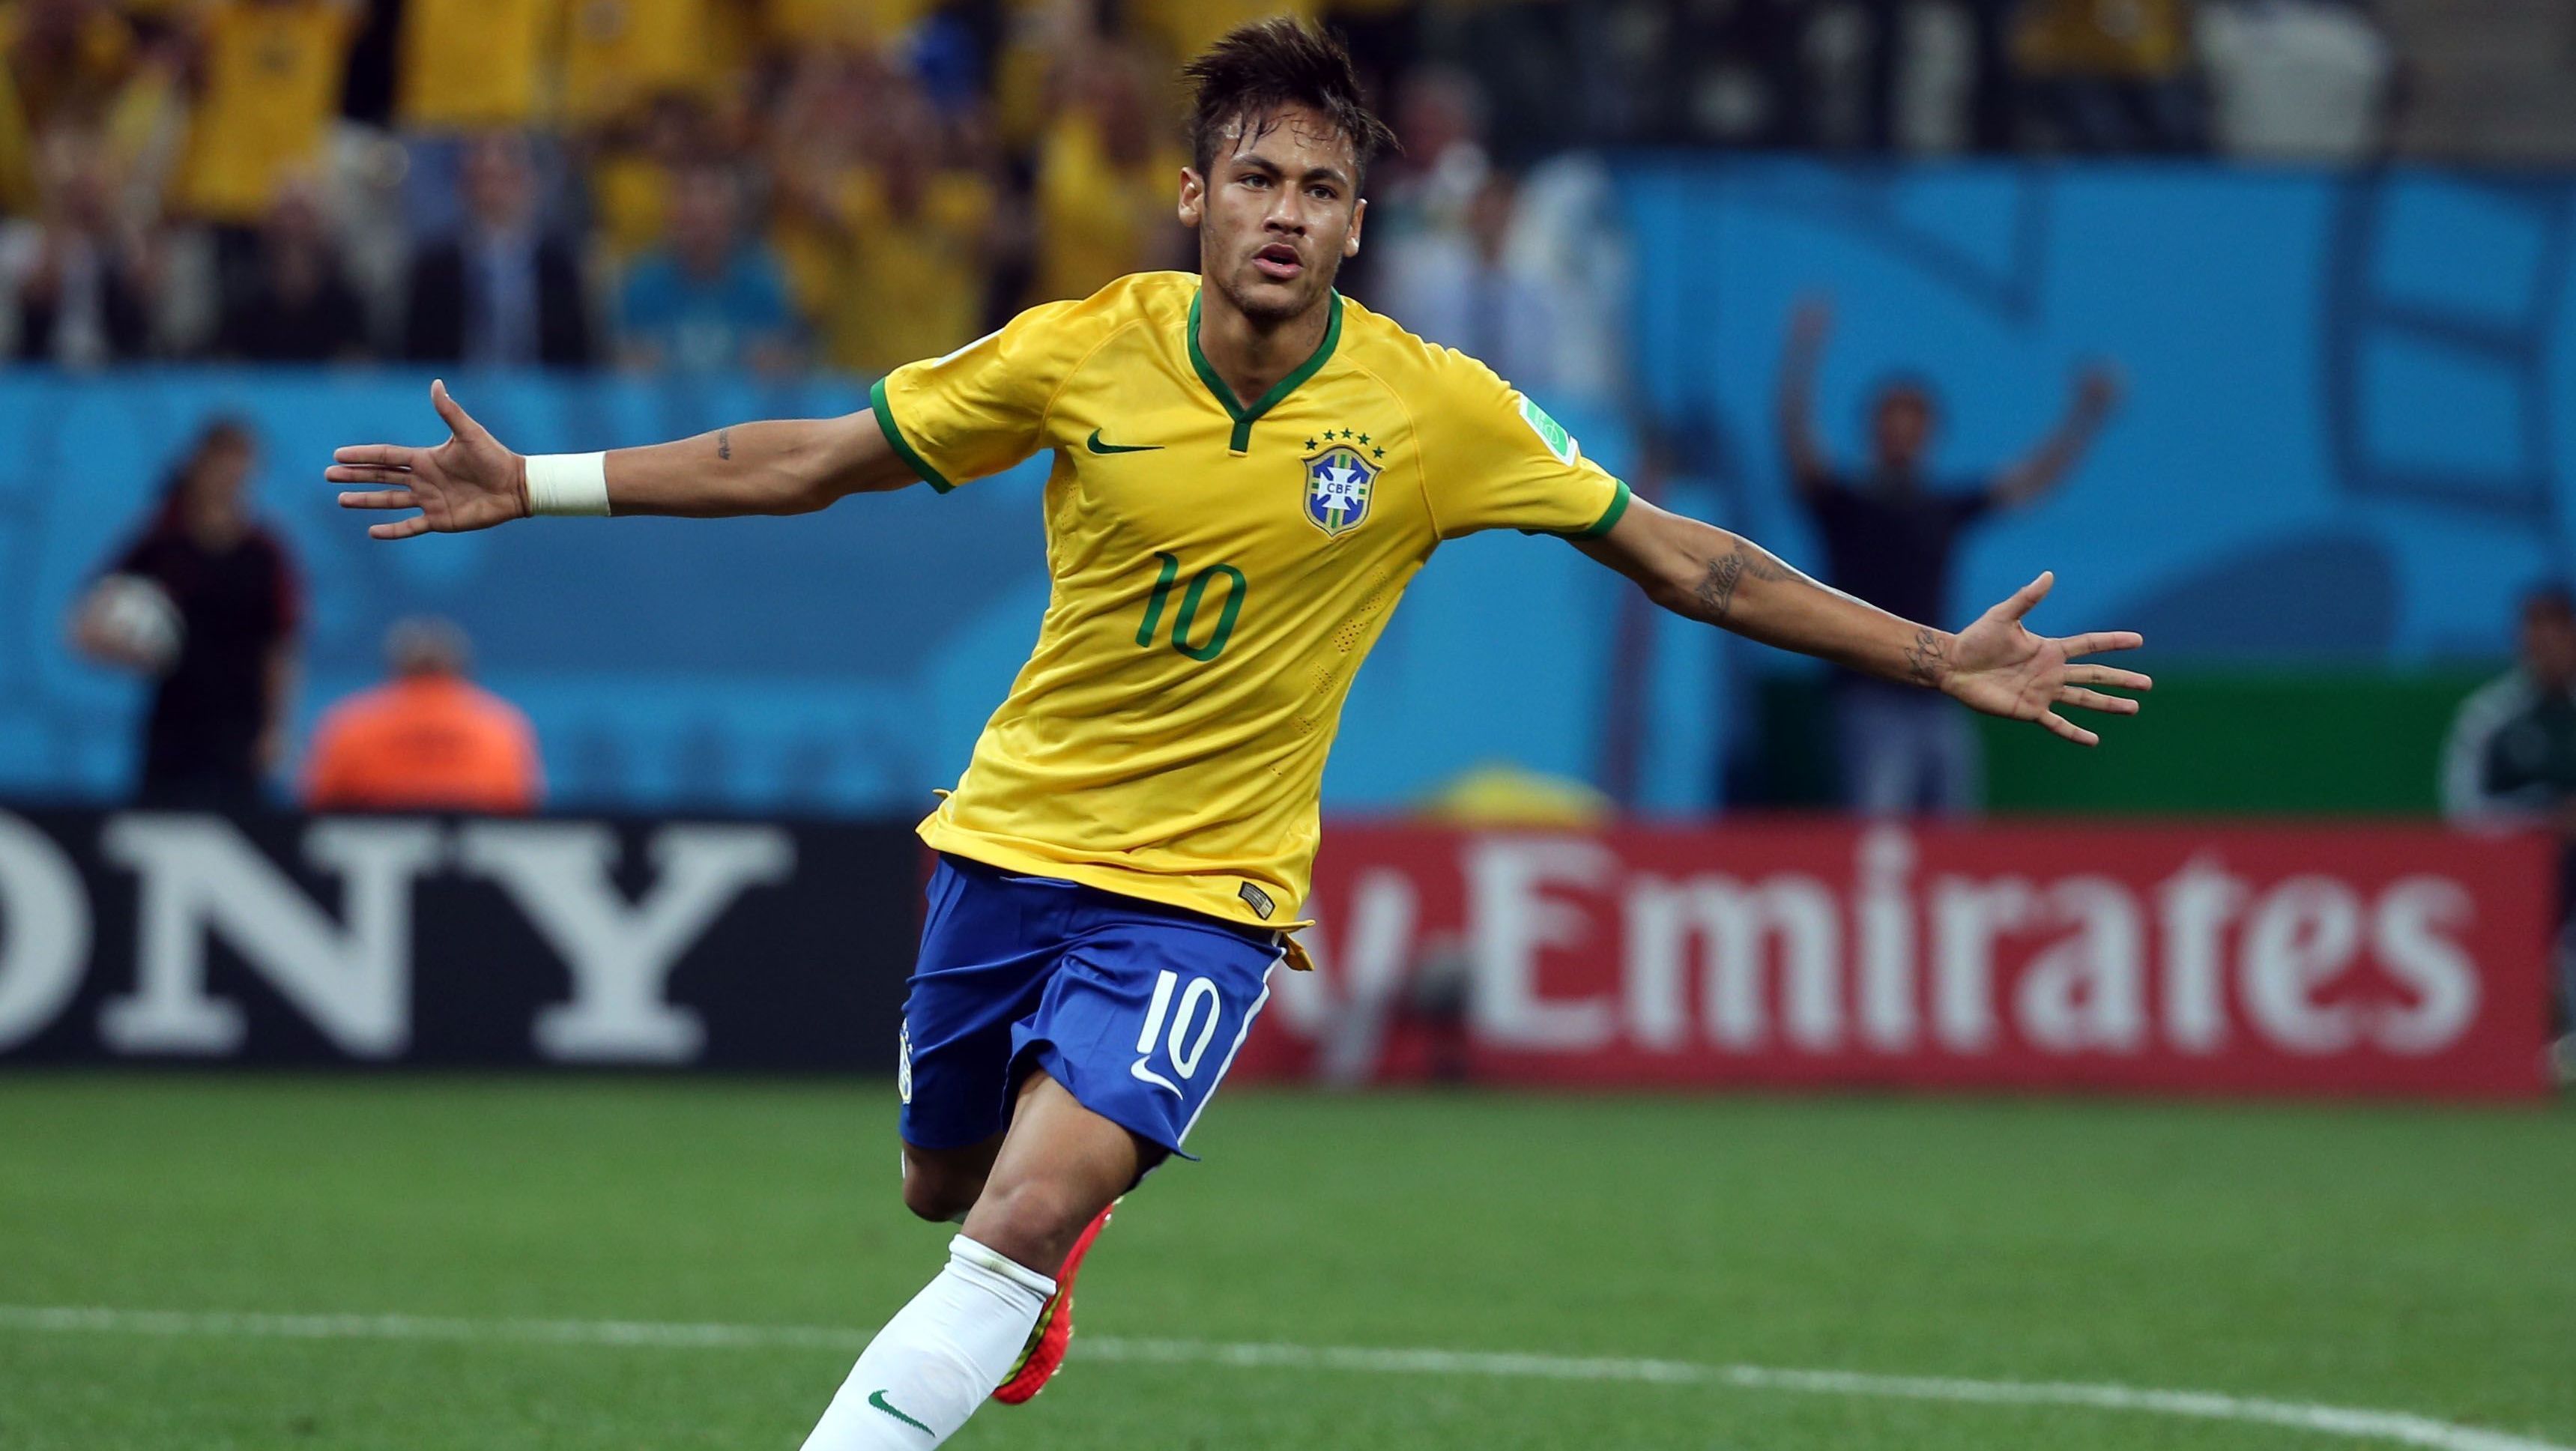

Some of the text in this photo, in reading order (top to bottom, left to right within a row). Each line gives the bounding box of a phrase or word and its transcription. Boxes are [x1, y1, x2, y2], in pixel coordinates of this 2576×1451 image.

[1326, 482, 1352, 494] CBF
[1135, 551, 1247, 661] 10
[1465, 826, 2480, 1053] Emirates
[1136, 969, 1221, 1079] 10
